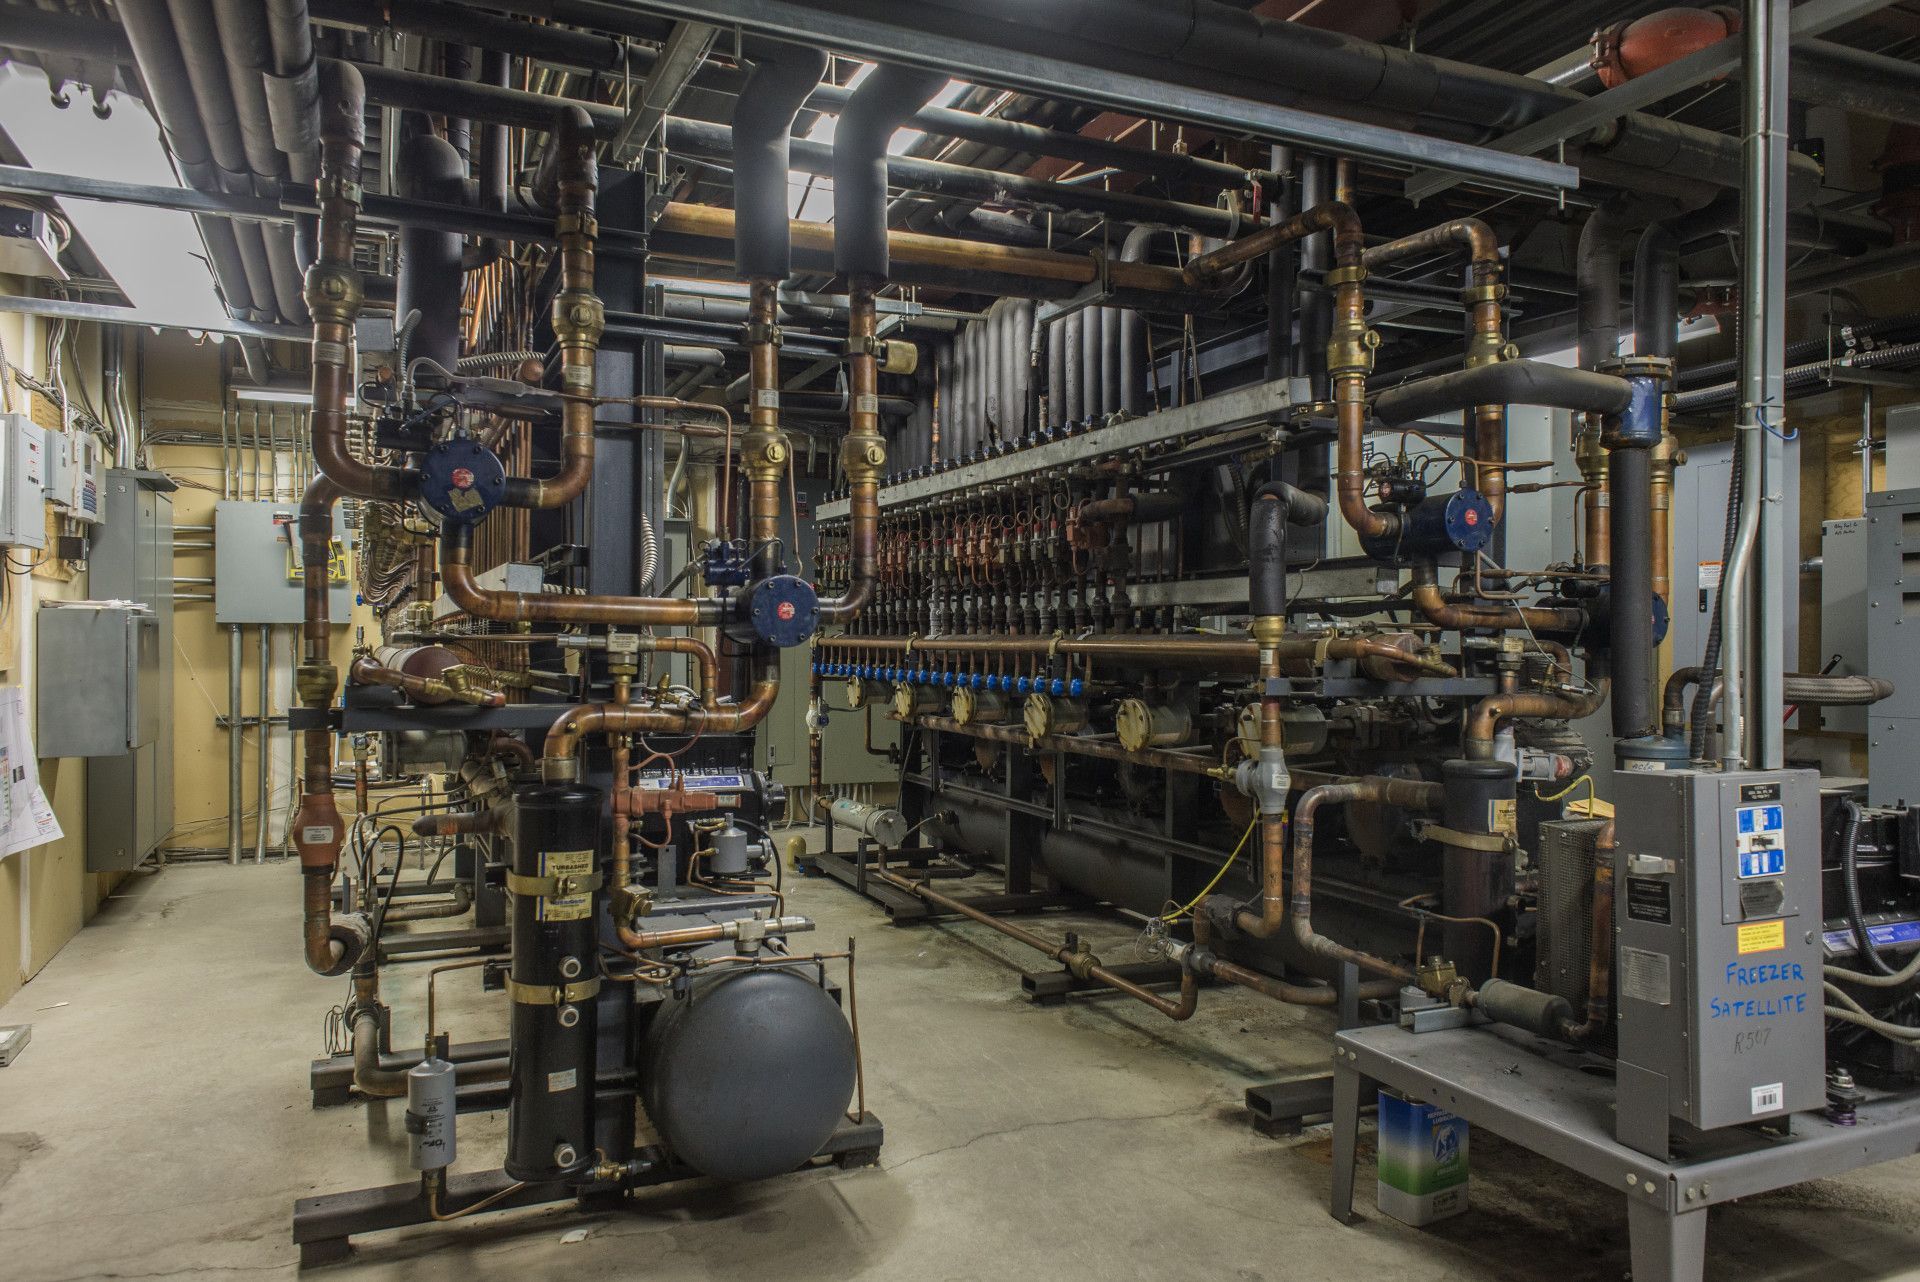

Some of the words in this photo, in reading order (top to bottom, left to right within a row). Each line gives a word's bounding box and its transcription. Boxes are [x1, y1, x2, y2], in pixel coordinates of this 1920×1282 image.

[1726, 962, 1804, 985] FREEZER
[1710, 993, 1807, 1018] SATELLITE
[1734, 1027, 1772, 1054] R507
